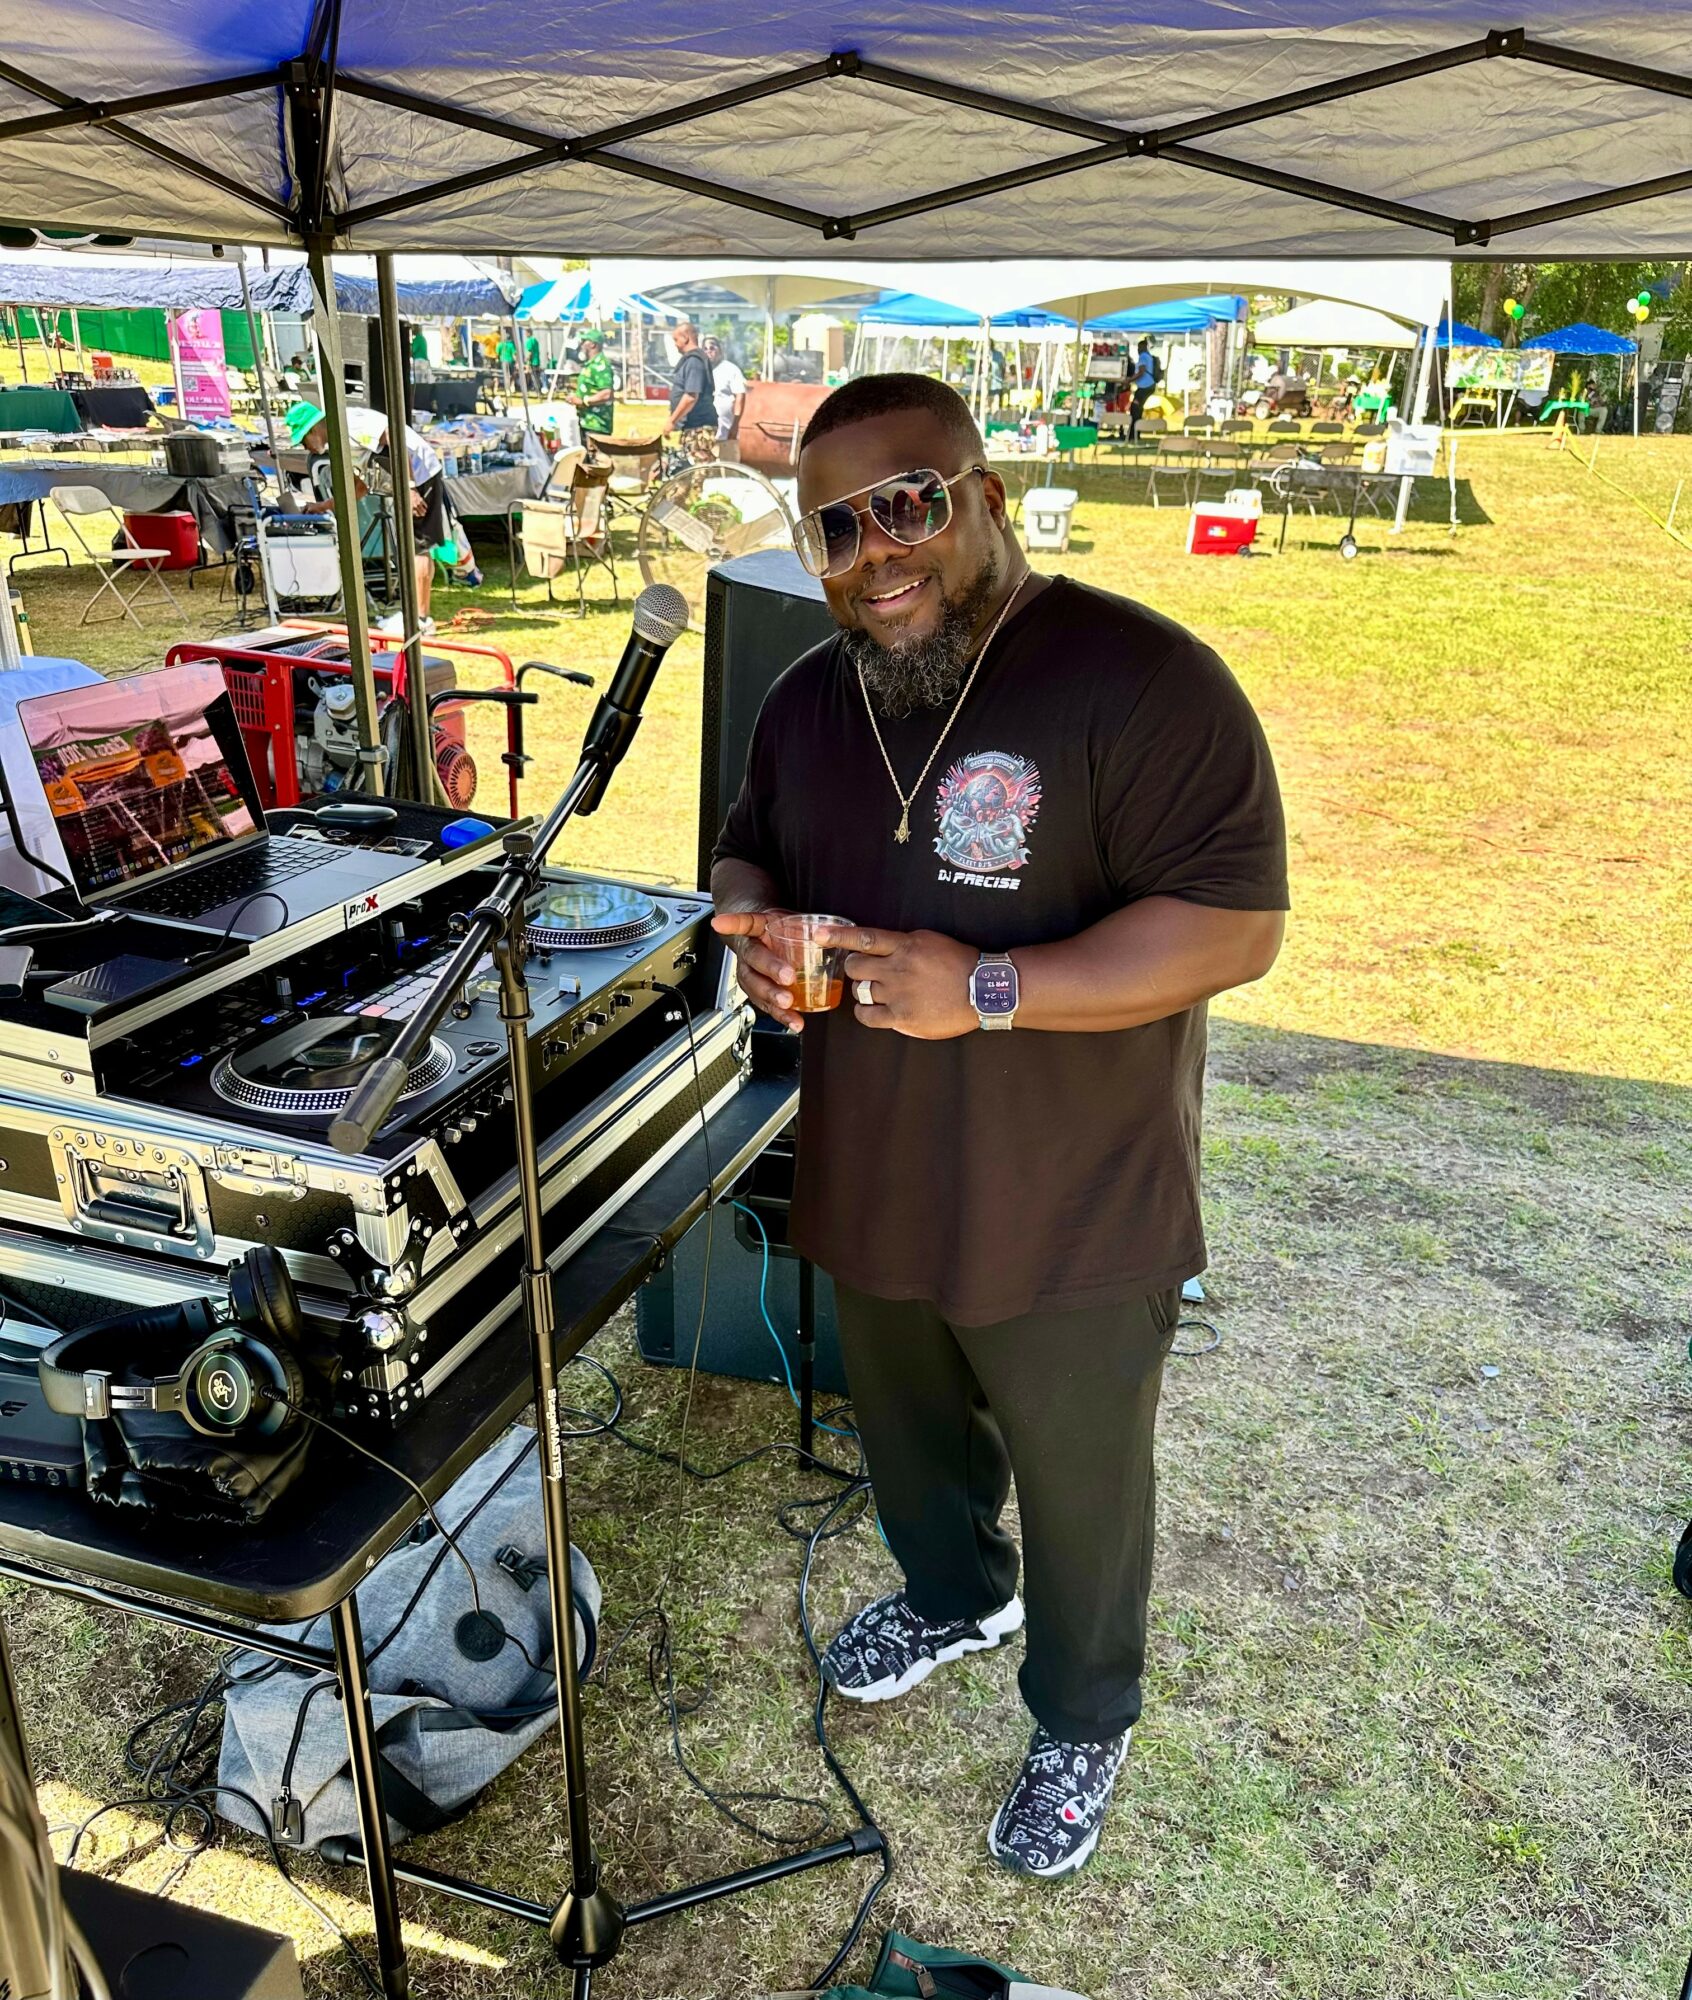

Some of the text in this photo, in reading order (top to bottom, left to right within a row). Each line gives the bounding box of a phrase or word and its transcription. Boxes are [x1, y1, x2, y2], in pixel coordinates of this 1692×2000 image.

[994, 758, 1016, 771] DIVISION
[960, 857, 976, 867] FLEET
[938, 869, 1021, 890] DJ PRECISE
[349, 893, 379, 919] ProX
[853, 1646, 874, 1684] CHAMPION
